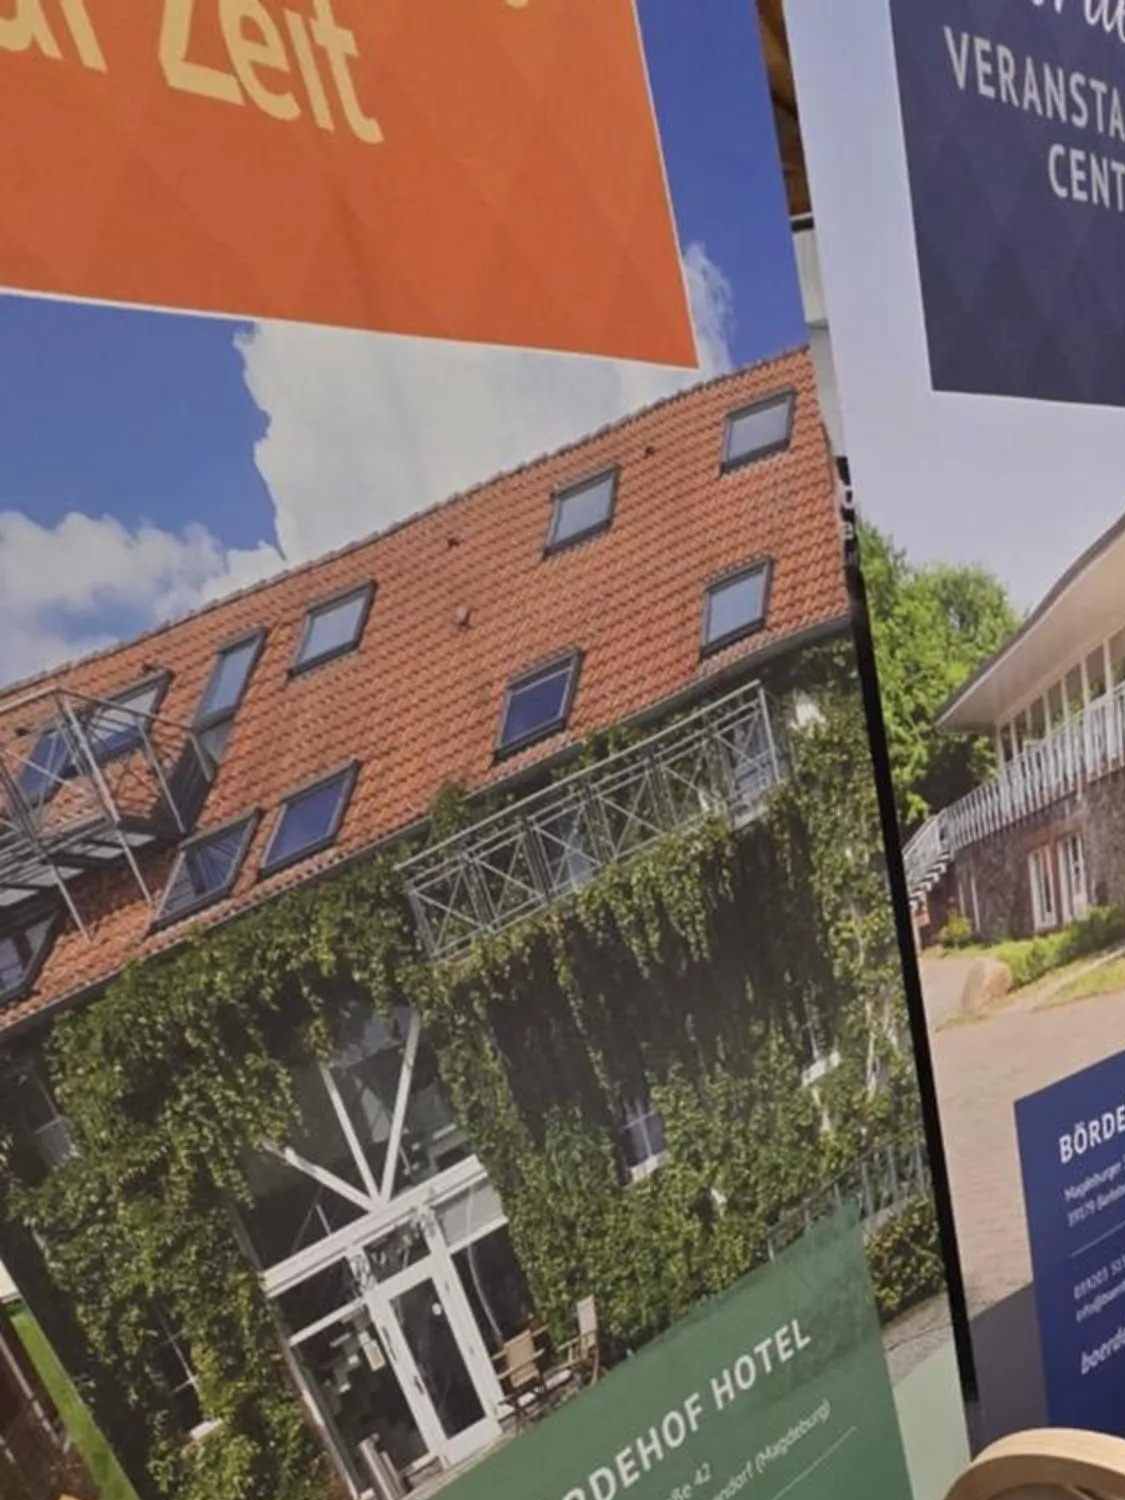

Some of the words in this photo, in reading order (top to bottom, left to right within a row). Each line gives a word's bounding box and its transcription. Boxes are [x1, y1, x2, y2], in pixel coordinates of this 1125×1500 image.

[711, 1317, 812, 1411] HOTEL
[694, 1462, 712, 1486] 42
[755, 1399, 832, 1474] (Magdeburg)
